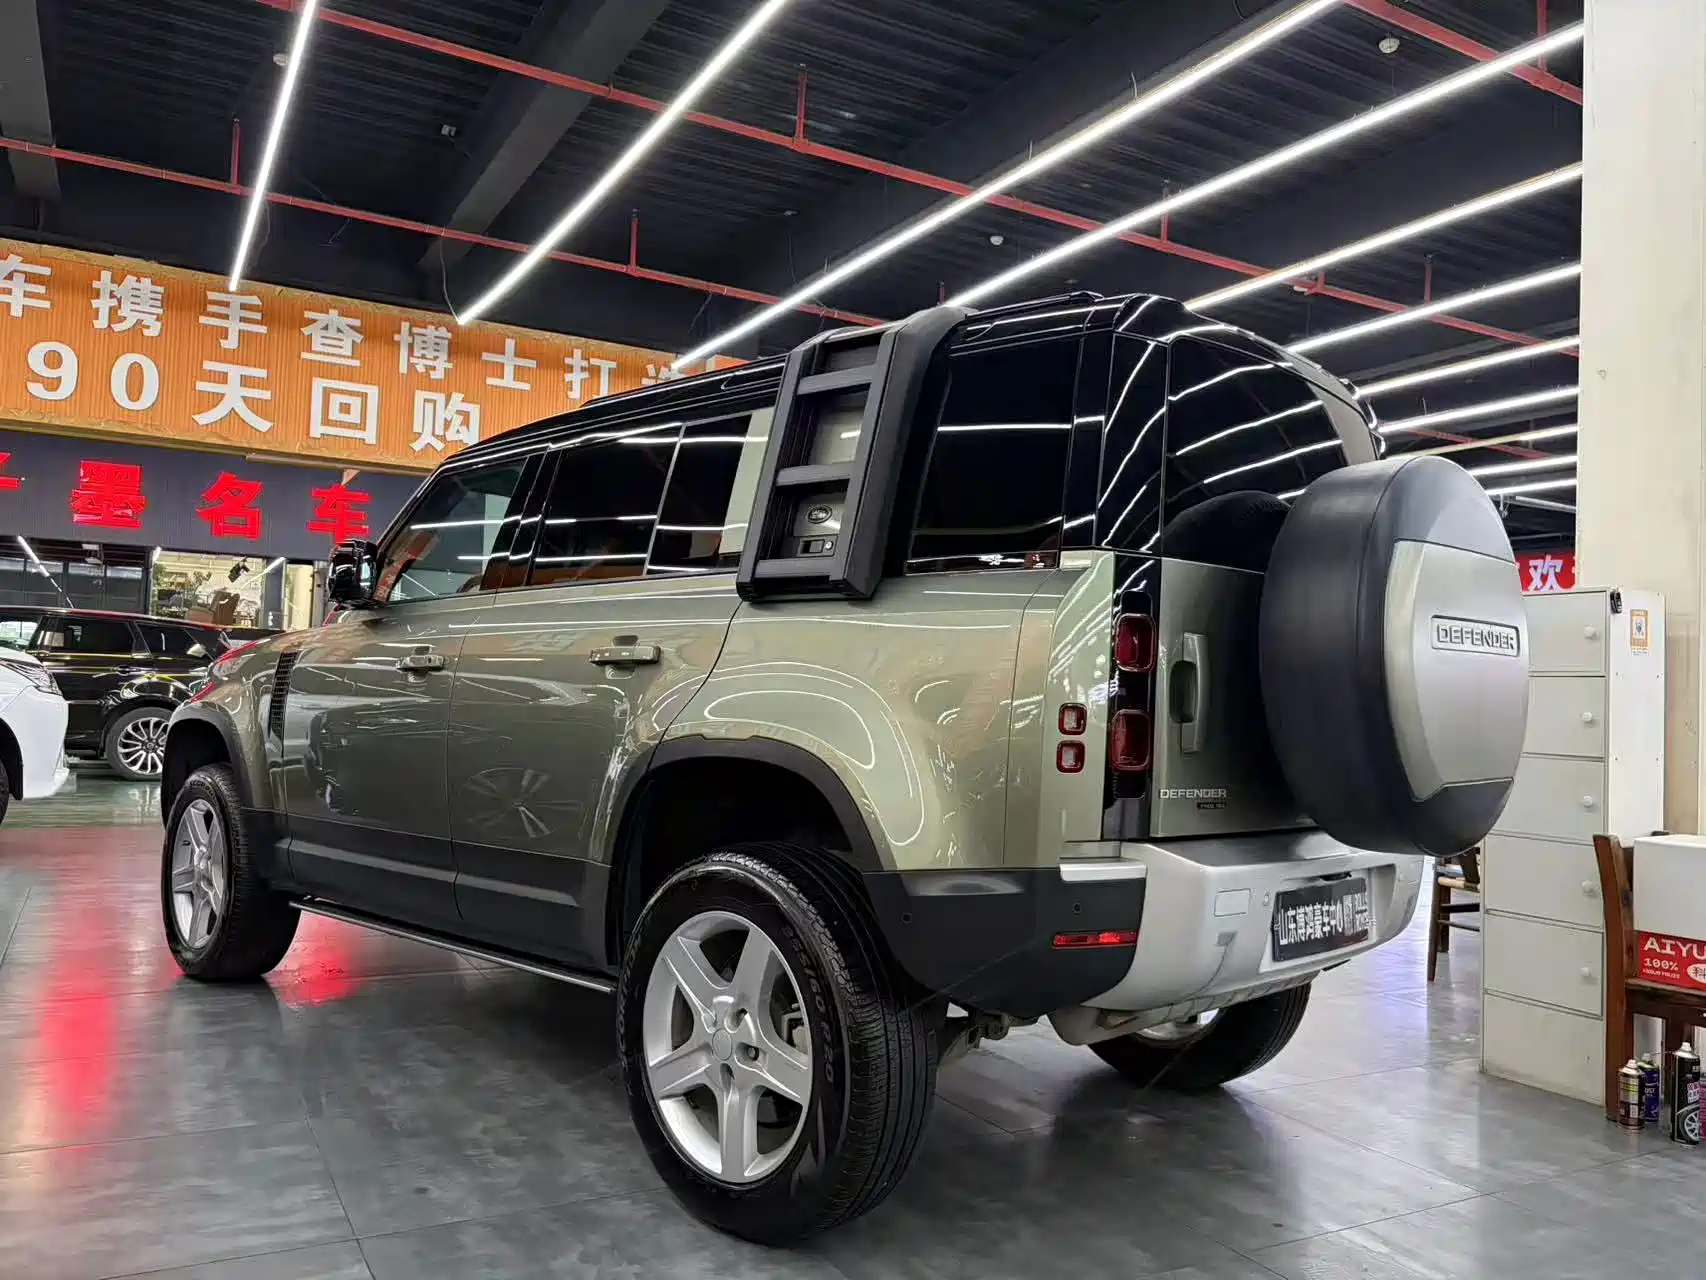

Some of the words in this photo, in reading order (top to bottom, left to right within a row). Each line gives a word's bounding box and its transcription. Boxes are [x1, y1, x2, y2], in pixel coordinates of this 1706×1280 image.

[0, 254, 684, 400] 车携手查博士打
[26, 340, 481, 453] 90天回购
[0, 450, 371, 546] 墨名车
[1436, 623, 1516, 650] DEFENDER
[1159, 788, 1228, 799] DEFENDER
[1643, 957, 1679, 971] 100%
